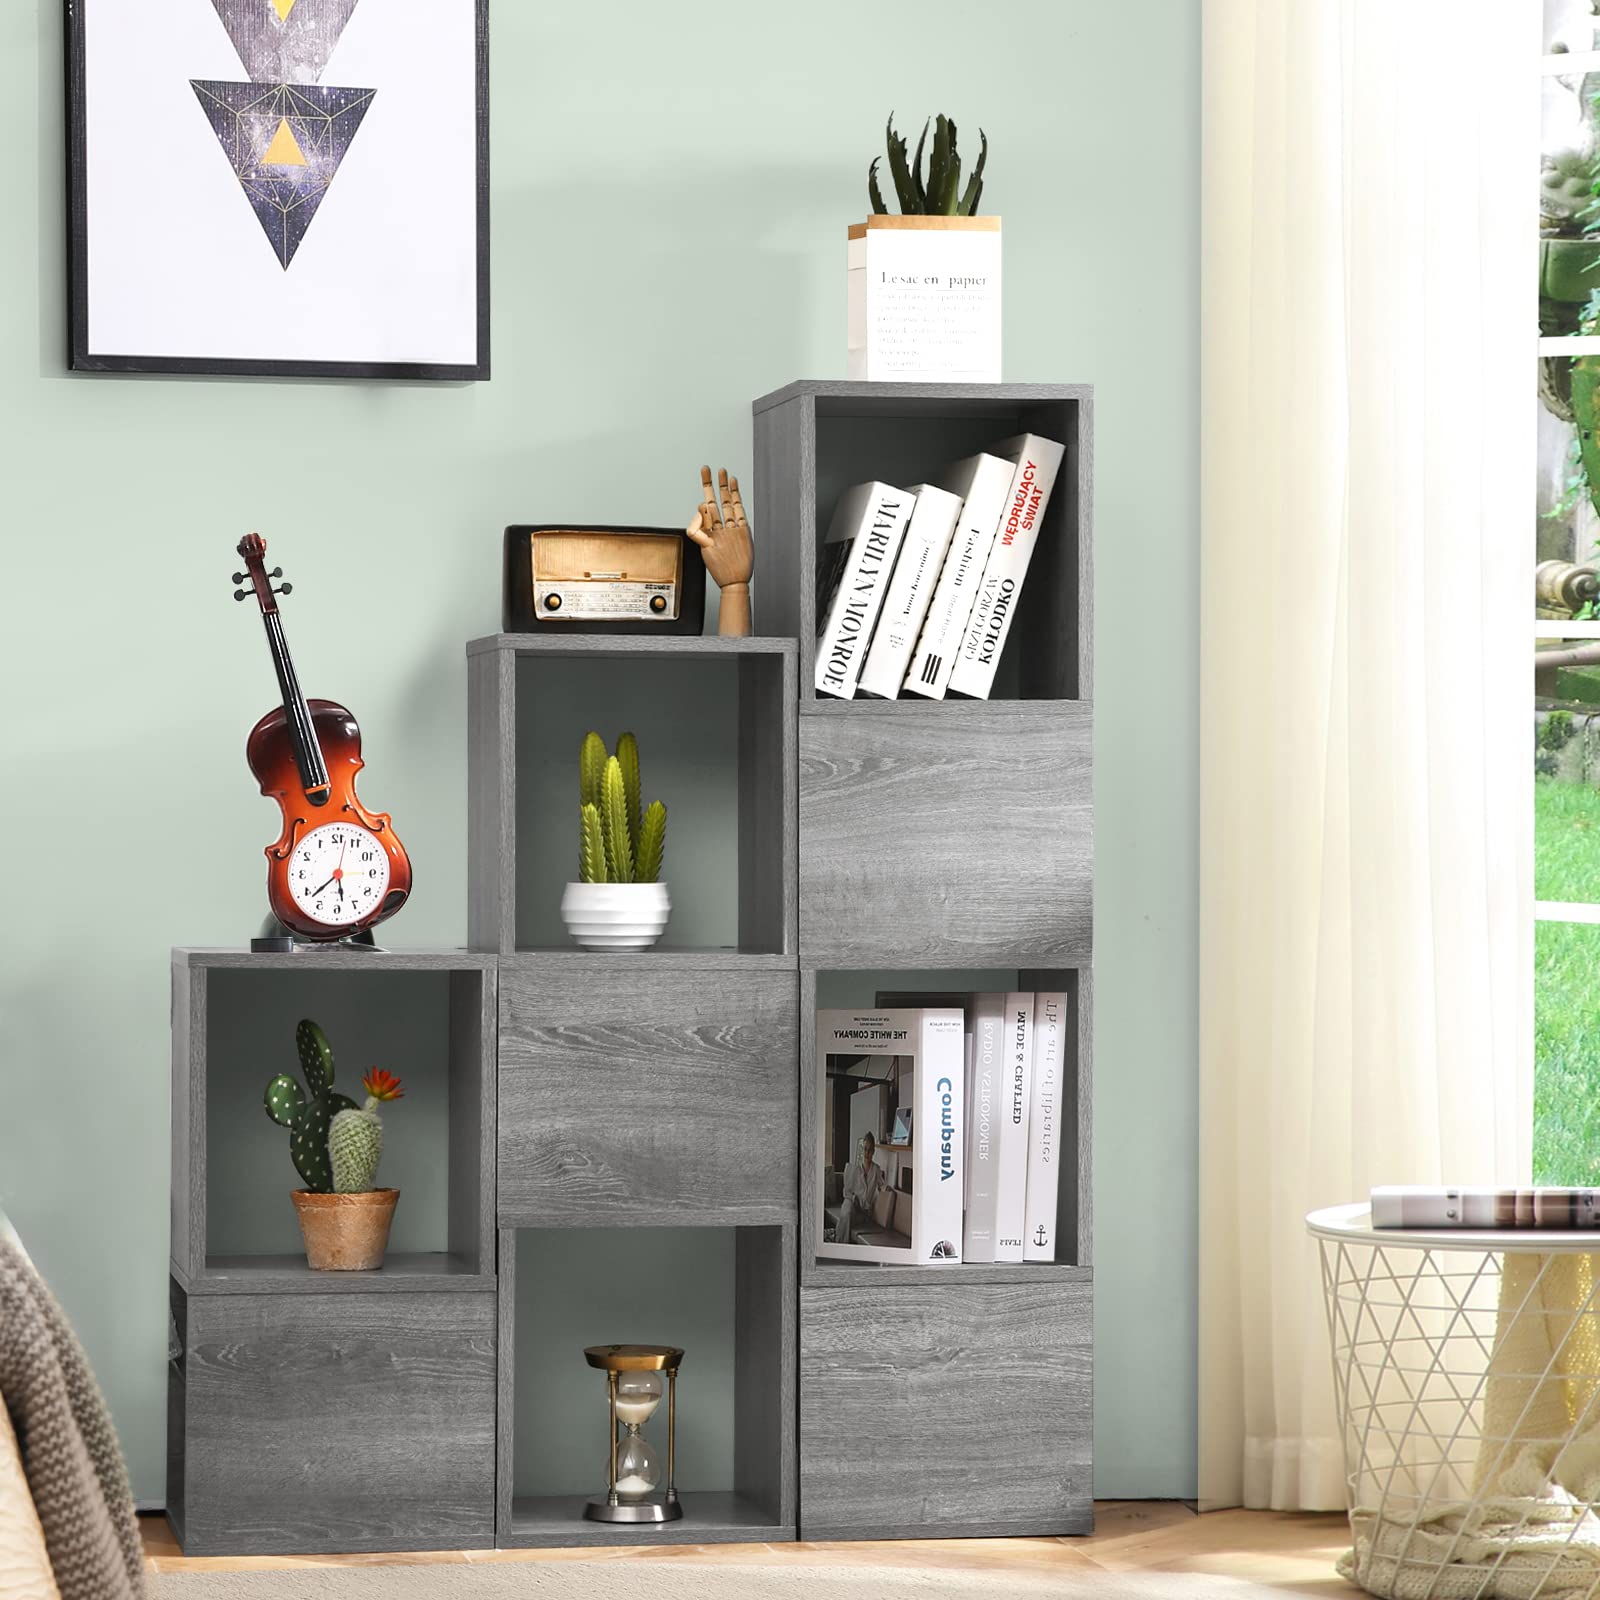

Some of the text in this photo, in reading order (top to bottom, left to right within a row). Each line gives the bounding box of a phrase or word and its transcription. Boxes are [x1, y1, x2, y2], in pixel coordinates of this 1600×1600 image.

[924, 275, 939, 285] en
[949, 274, 987, 289] papier
[1021, 485, 1044, 531] ŚWIAT
[954, 528, 980, 587] Fashion
[822, 498, 901, 690] MARILYN MONROE
[977, 578, 1016, 665] KOŁODKO
